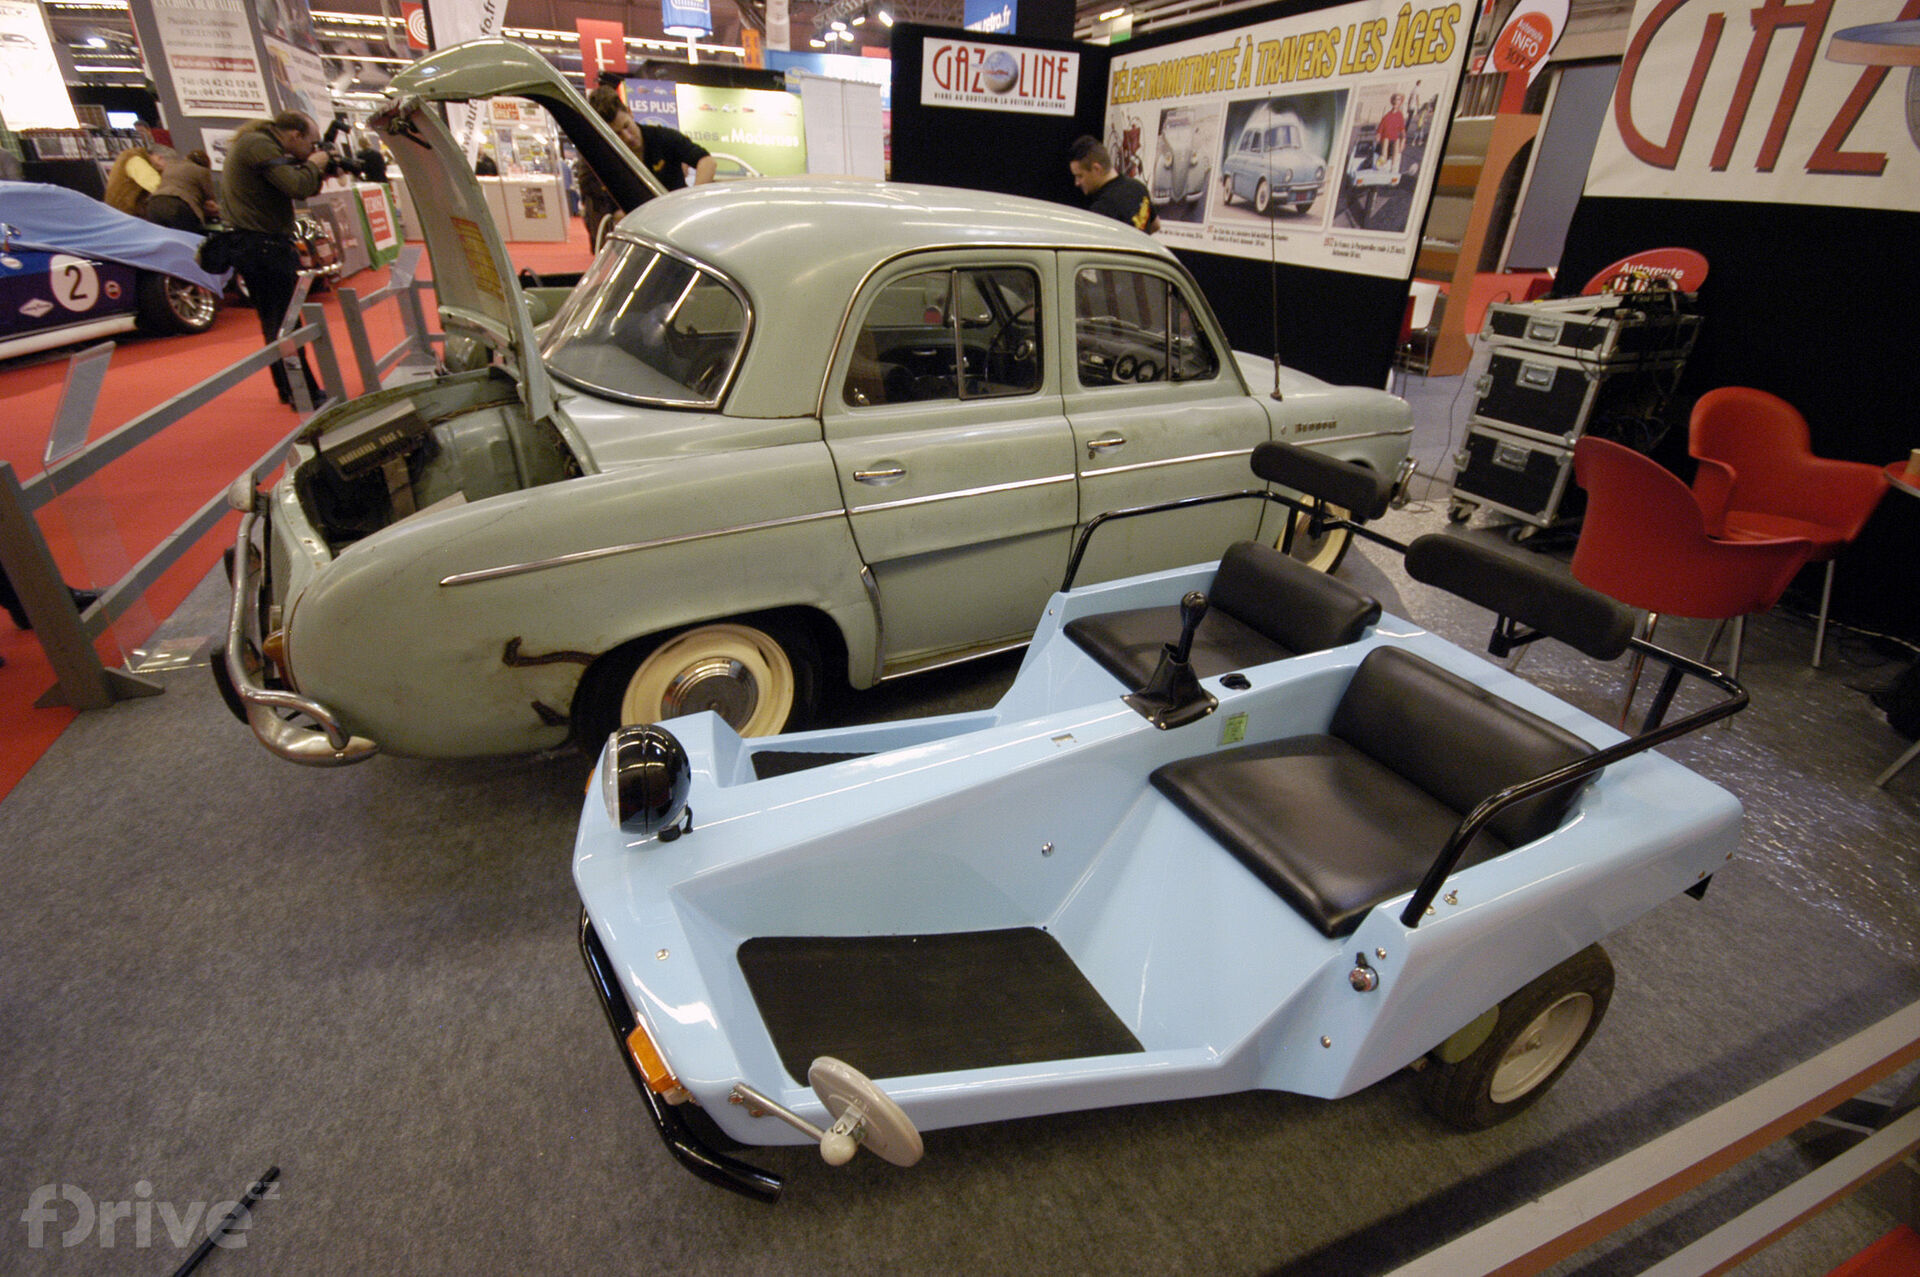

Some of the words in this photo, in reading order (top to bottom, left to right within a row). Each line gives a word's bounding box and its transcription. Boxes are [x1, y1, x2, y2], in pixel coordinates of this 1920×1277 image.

[1111, 37, 1241, 106] L'ÉLECTROMOTRICITÉ
[1238, 35, 1253, 88] À
[1255, 27, 1341, 87] TRAVERS
[1340, 18, 1387, 75] LES
[1384, 3, 1462, 69] ÂGES
[1511, 30, 1539, 57] INFO
[629, 99, 648, 112] LES
[650, 101, 676, 114] PLUS
[731, 127, 799, 148] Modernes
[65, 264, 88, 300] 2
[1620, 262, 1684, 279] Autoroute
